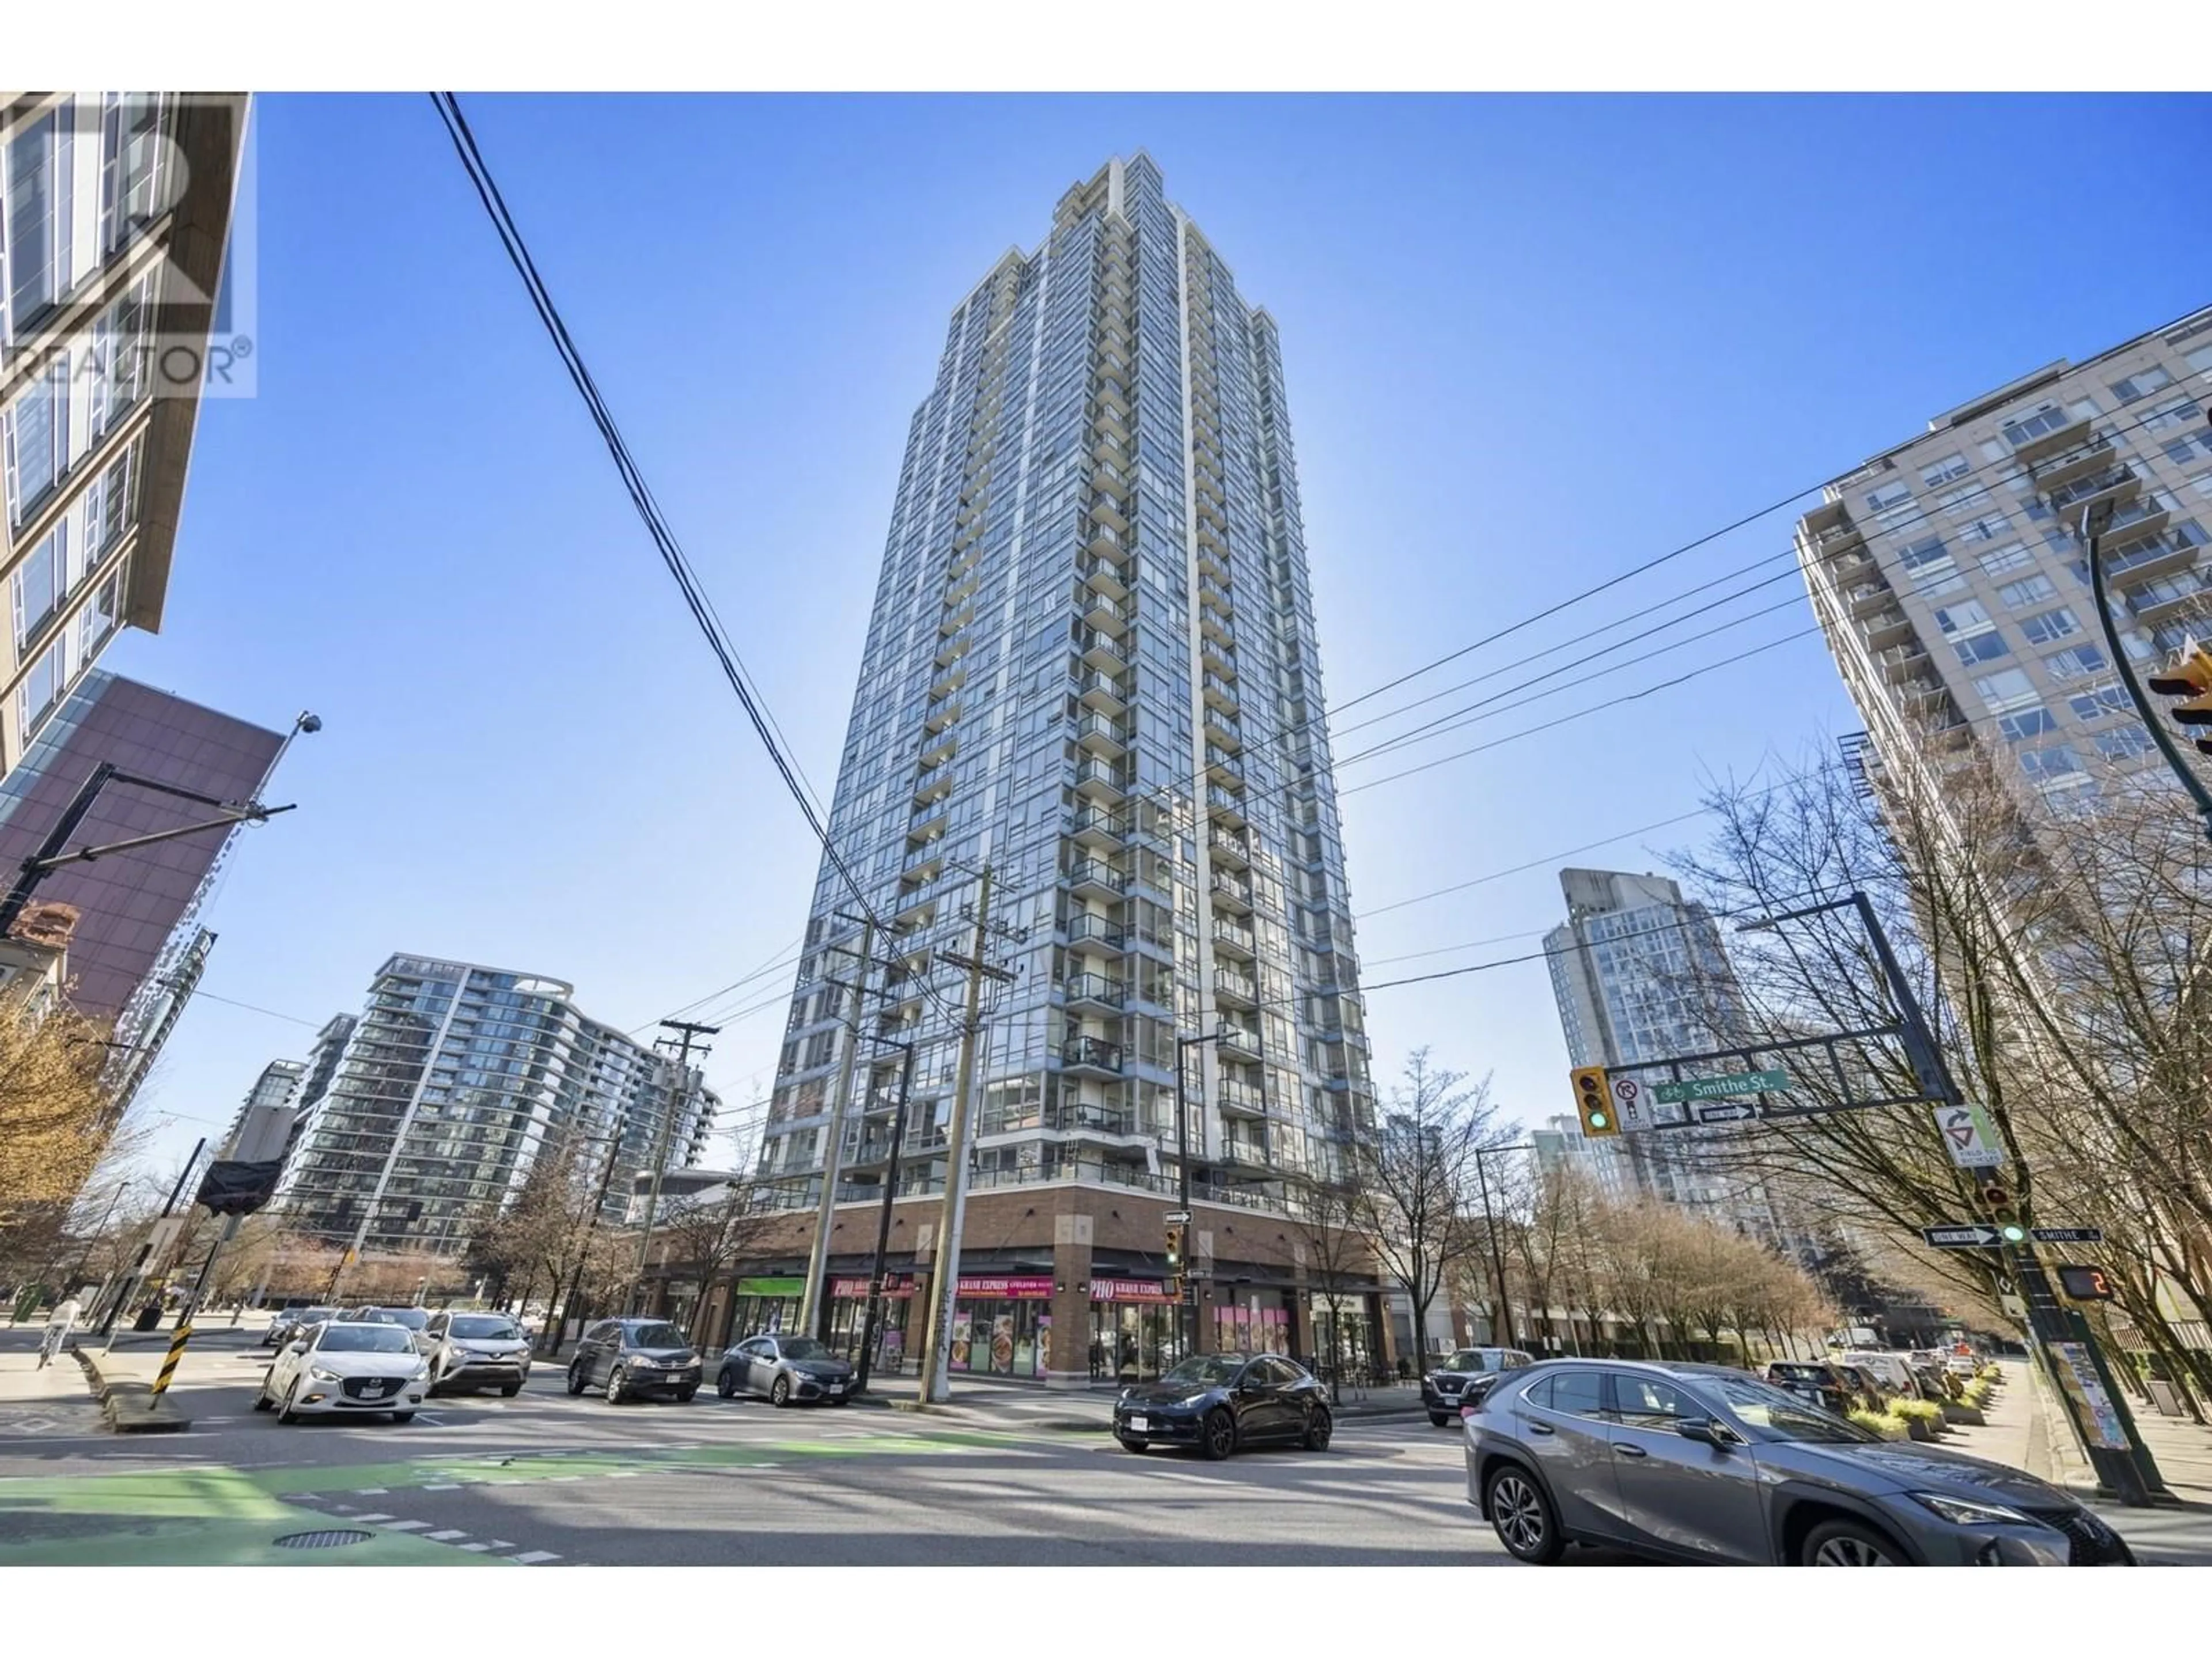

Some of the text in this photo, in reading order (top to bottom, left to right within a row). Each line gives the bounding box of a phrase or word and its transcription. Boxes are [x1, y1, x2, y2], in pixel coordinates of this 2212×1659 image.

[1692, 1075, 1774, 1096] Smithe St.
[1961, 1155, 2001, 1164] BICYCLES
[1933, 1232, 1977, 1241] ONE WAY
[2039, 1230, 2080, 1240] SMITHE
[1090, 1280, 1113, 1299] PHO
[2090, 1271, 2108, 1294] 2
